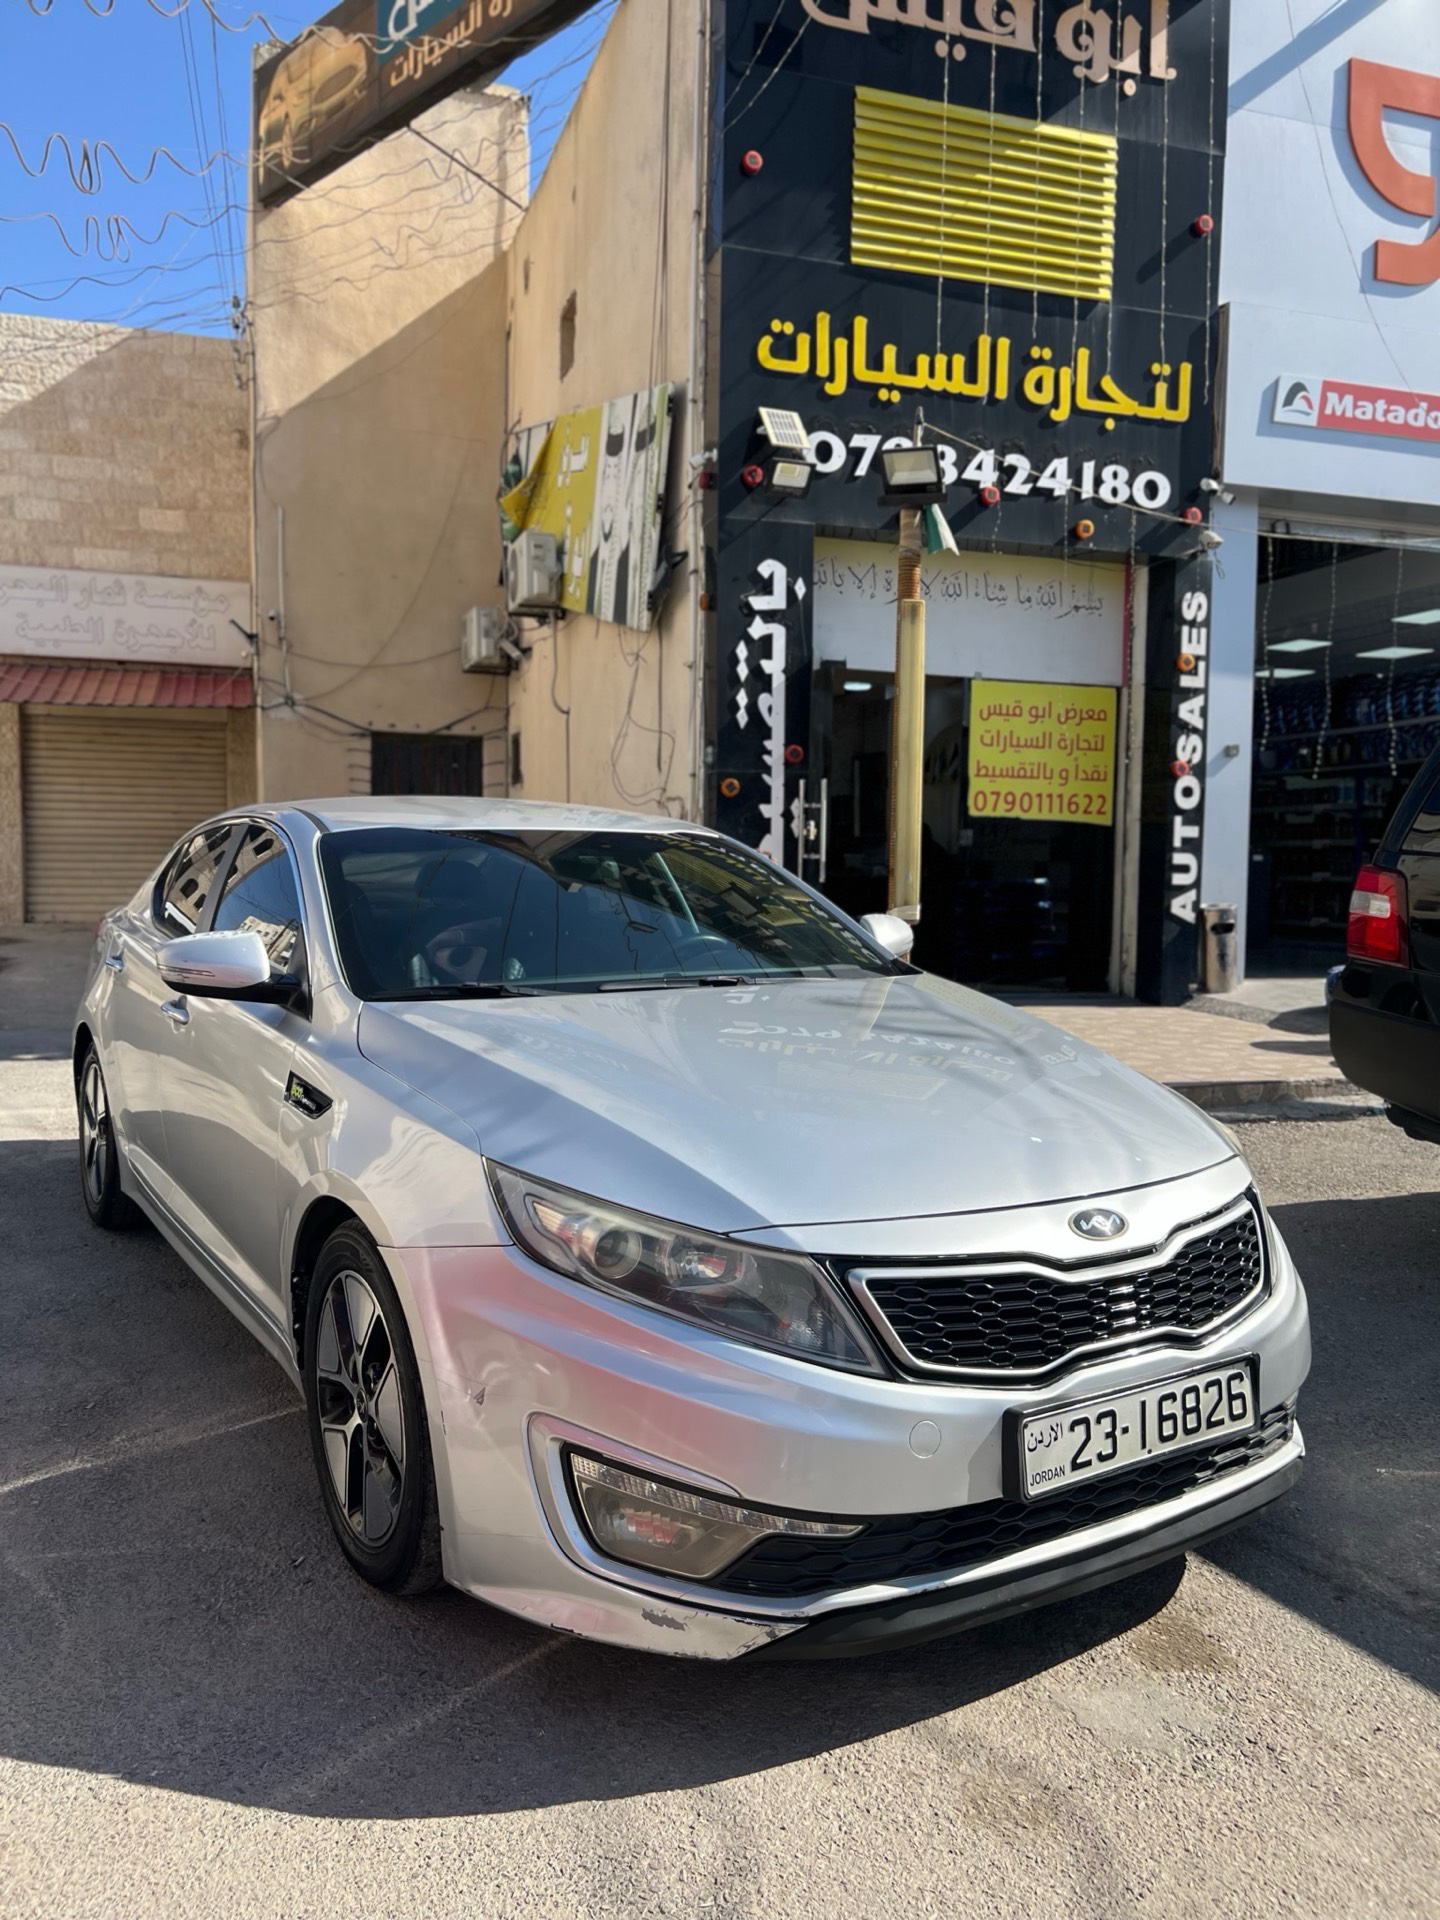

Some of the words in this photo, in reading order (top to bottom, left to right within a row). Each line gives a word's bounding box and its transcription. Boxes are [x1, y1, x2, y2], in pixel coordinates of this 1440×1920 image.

[757, 311, 1010, 402] السيارات
[1023, 345, 1192, 430] لتجارة
[134, 580, 230, 618] مؤسسة
[15, 612, 104, 649] الطبية
[979, 700, 1023, 721] قيس
[1028, 701, 1052, 724] ابو
[1056, 702, 1108, 726] معرض
[979, 729, 1053, 754] السيارات
[1056, 732, 1105, 757] لتجارة
[973, 759, 1054, 785] بالتقسيط
[1058, 768, 1069, 786] و
[973, 790, 1107, 816] 0790111622
[1026, 1422, 1064, 1452] الاردن
[1029, 1465, 1066, 1487] JORDAN
